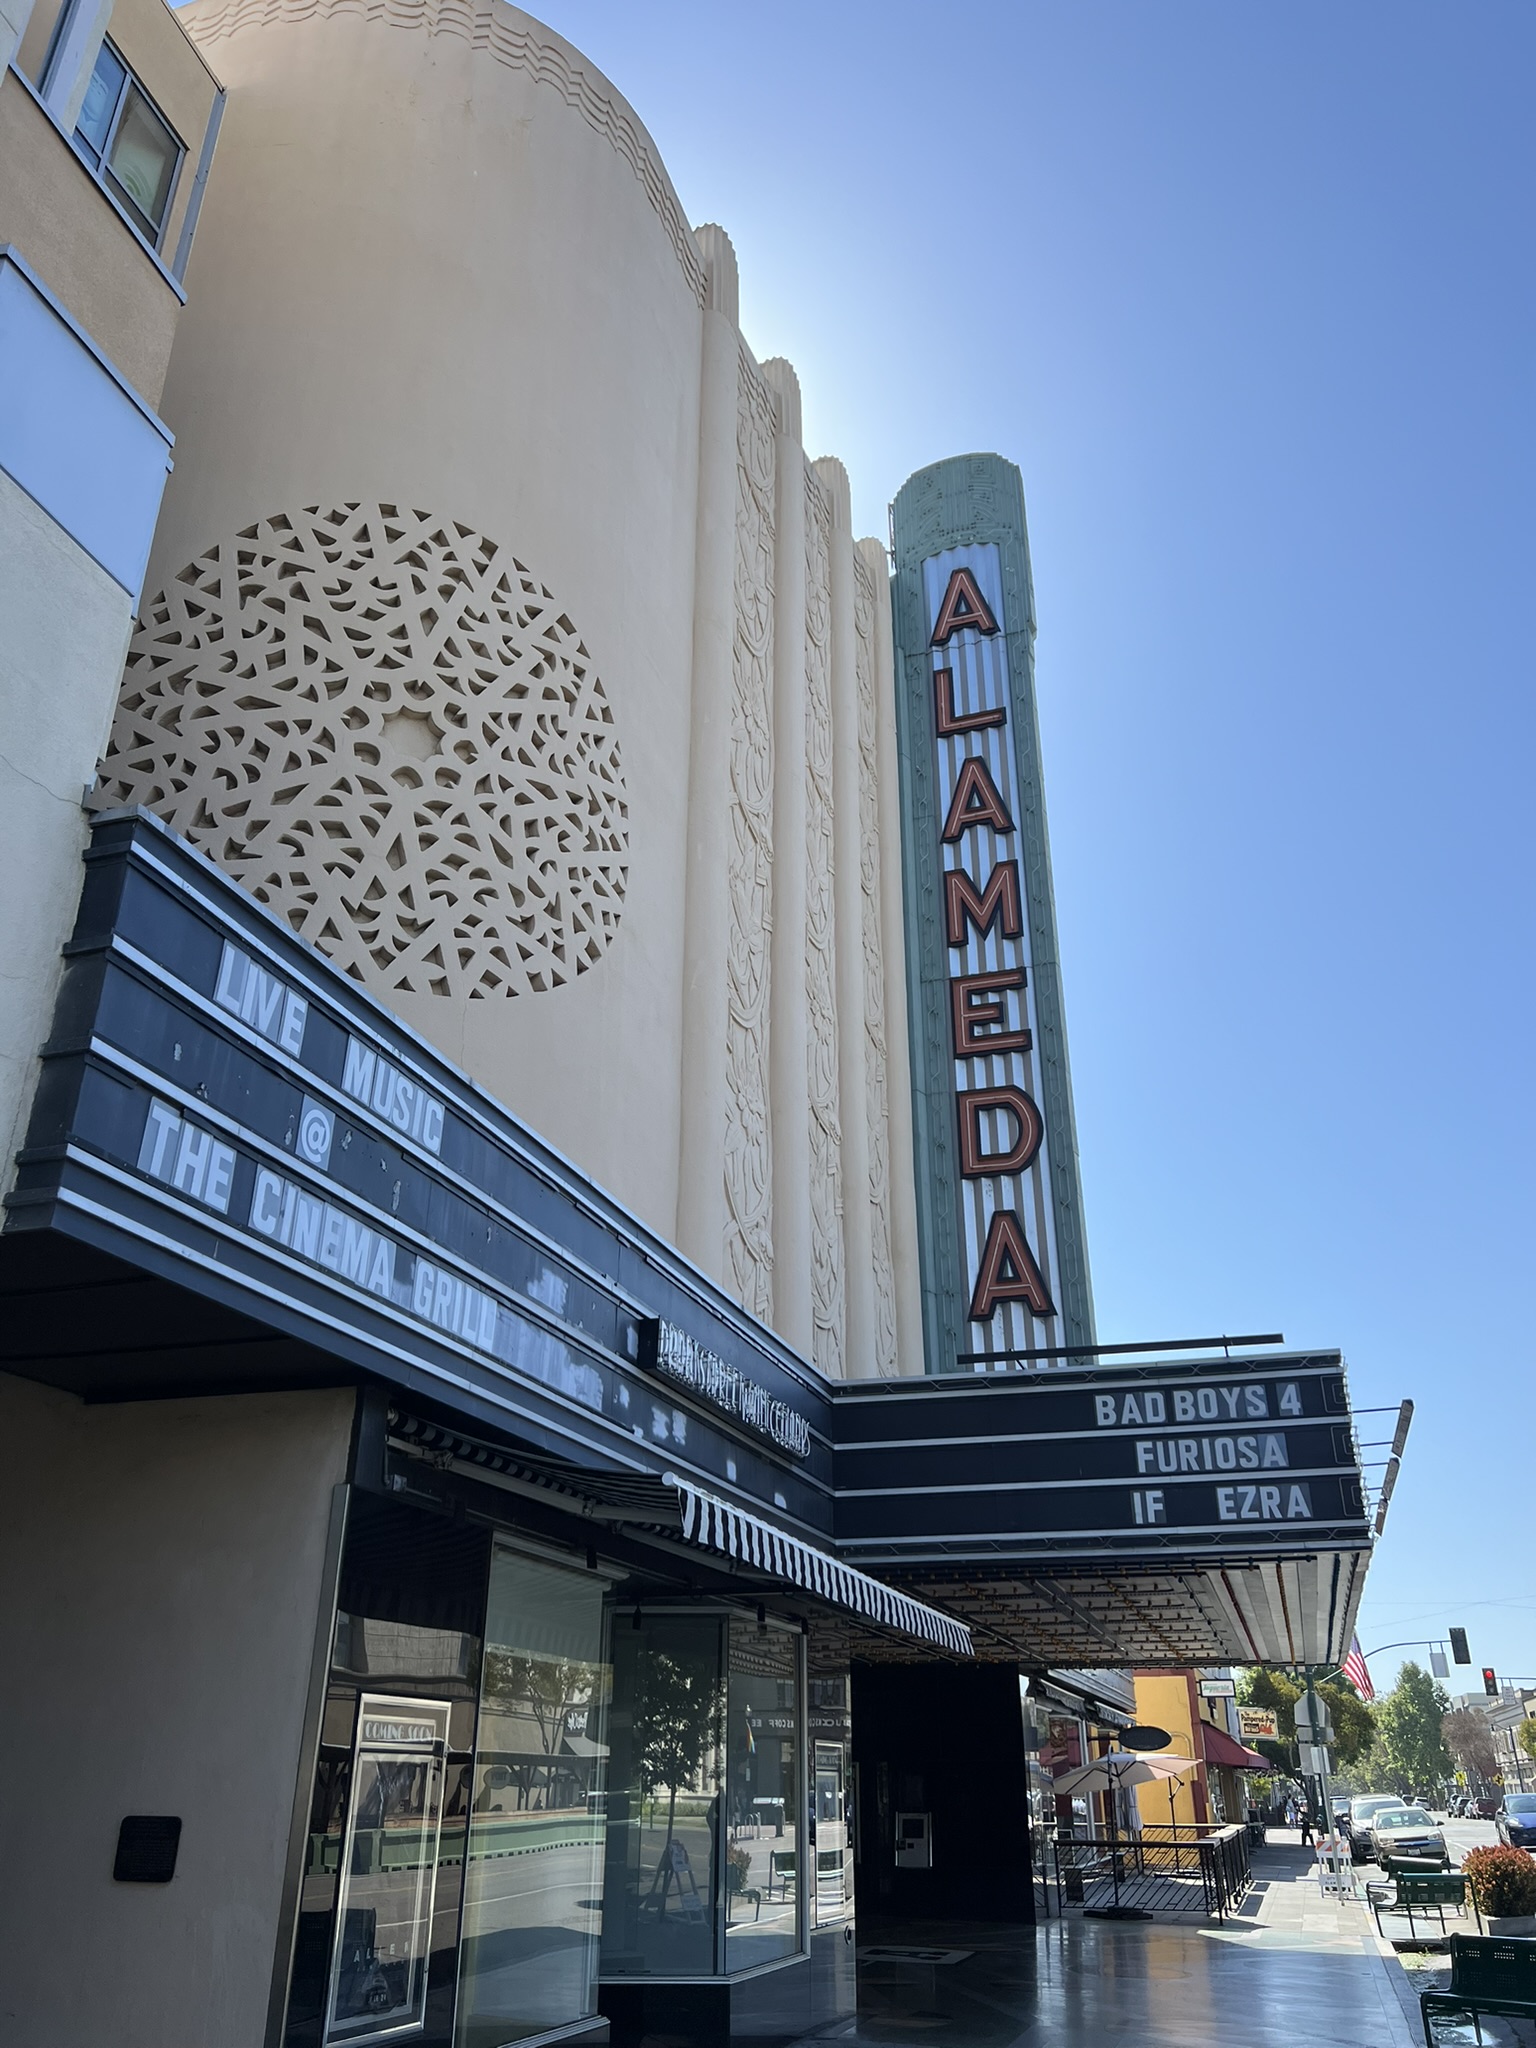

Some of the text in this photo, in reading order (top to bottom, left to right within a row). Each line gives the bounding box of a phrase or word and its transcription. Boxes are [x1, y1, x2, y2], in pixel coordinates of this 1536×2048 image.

[929, 566, 1058, 1322] ALAMEDA
[216, 947, 444, 1152] LIVE MUSIC
[302, 1110, 332, 1162] @
[149, 1104, 235, 1211] THE
[252, 1169, 393, 1298] CINEMA
[1095, 1383, 1301, 1426] BAD BOYS 4
[1136, 1434, 1290, 1473] FURIOSA
[1132, 1485, 1311, 1524] IF EZRA
[365, 1721, 405, 1740] COMING
